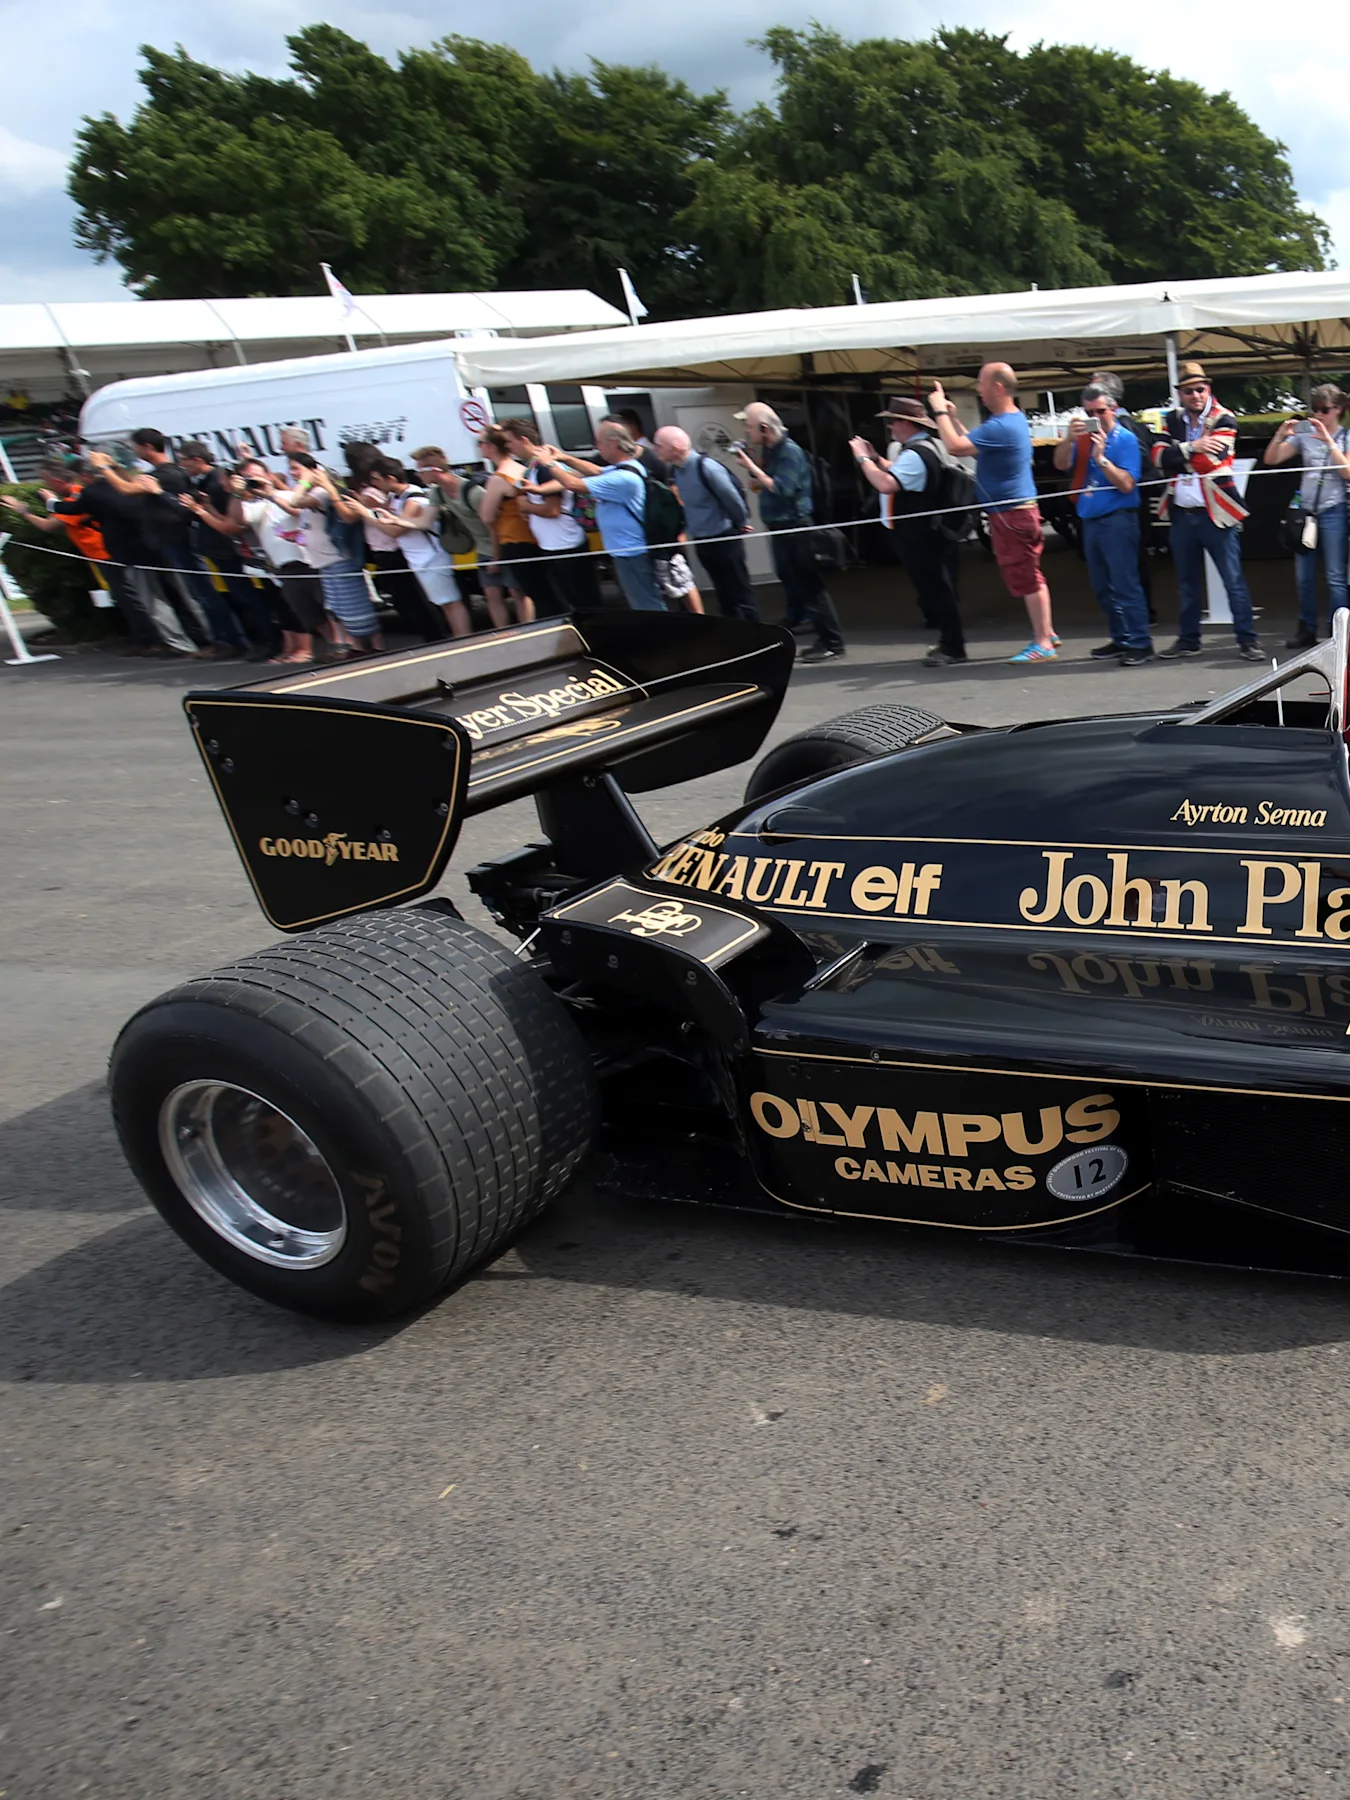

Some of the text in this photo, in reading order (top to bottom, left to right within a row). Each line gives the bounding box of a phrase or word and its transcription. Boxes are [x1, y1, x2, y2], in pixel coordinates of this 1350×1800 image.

[455, 704, 512, 741] yer
[499, 669, 626, 717] Special
[1169, 798, 1328, 828] Ayrton Senna
[259, 834, 400, 864] GOODYEAR
[650, 842, 944, 916] RENAULT elf
[1018, 850, 1214, 934] John
[749, 1090, 1121, 1158] OLYMPUS
[833, 1156, 1037, 1192] CAMERAS
[1052, 1152, 1084, 1173] GOODWOOD
[1084, 1146, 1109, 1155] FESTIVAL
[1073, 1158, 1107, 1189] 12
[1056, 1191, 1086, 1200] PRESENTED
